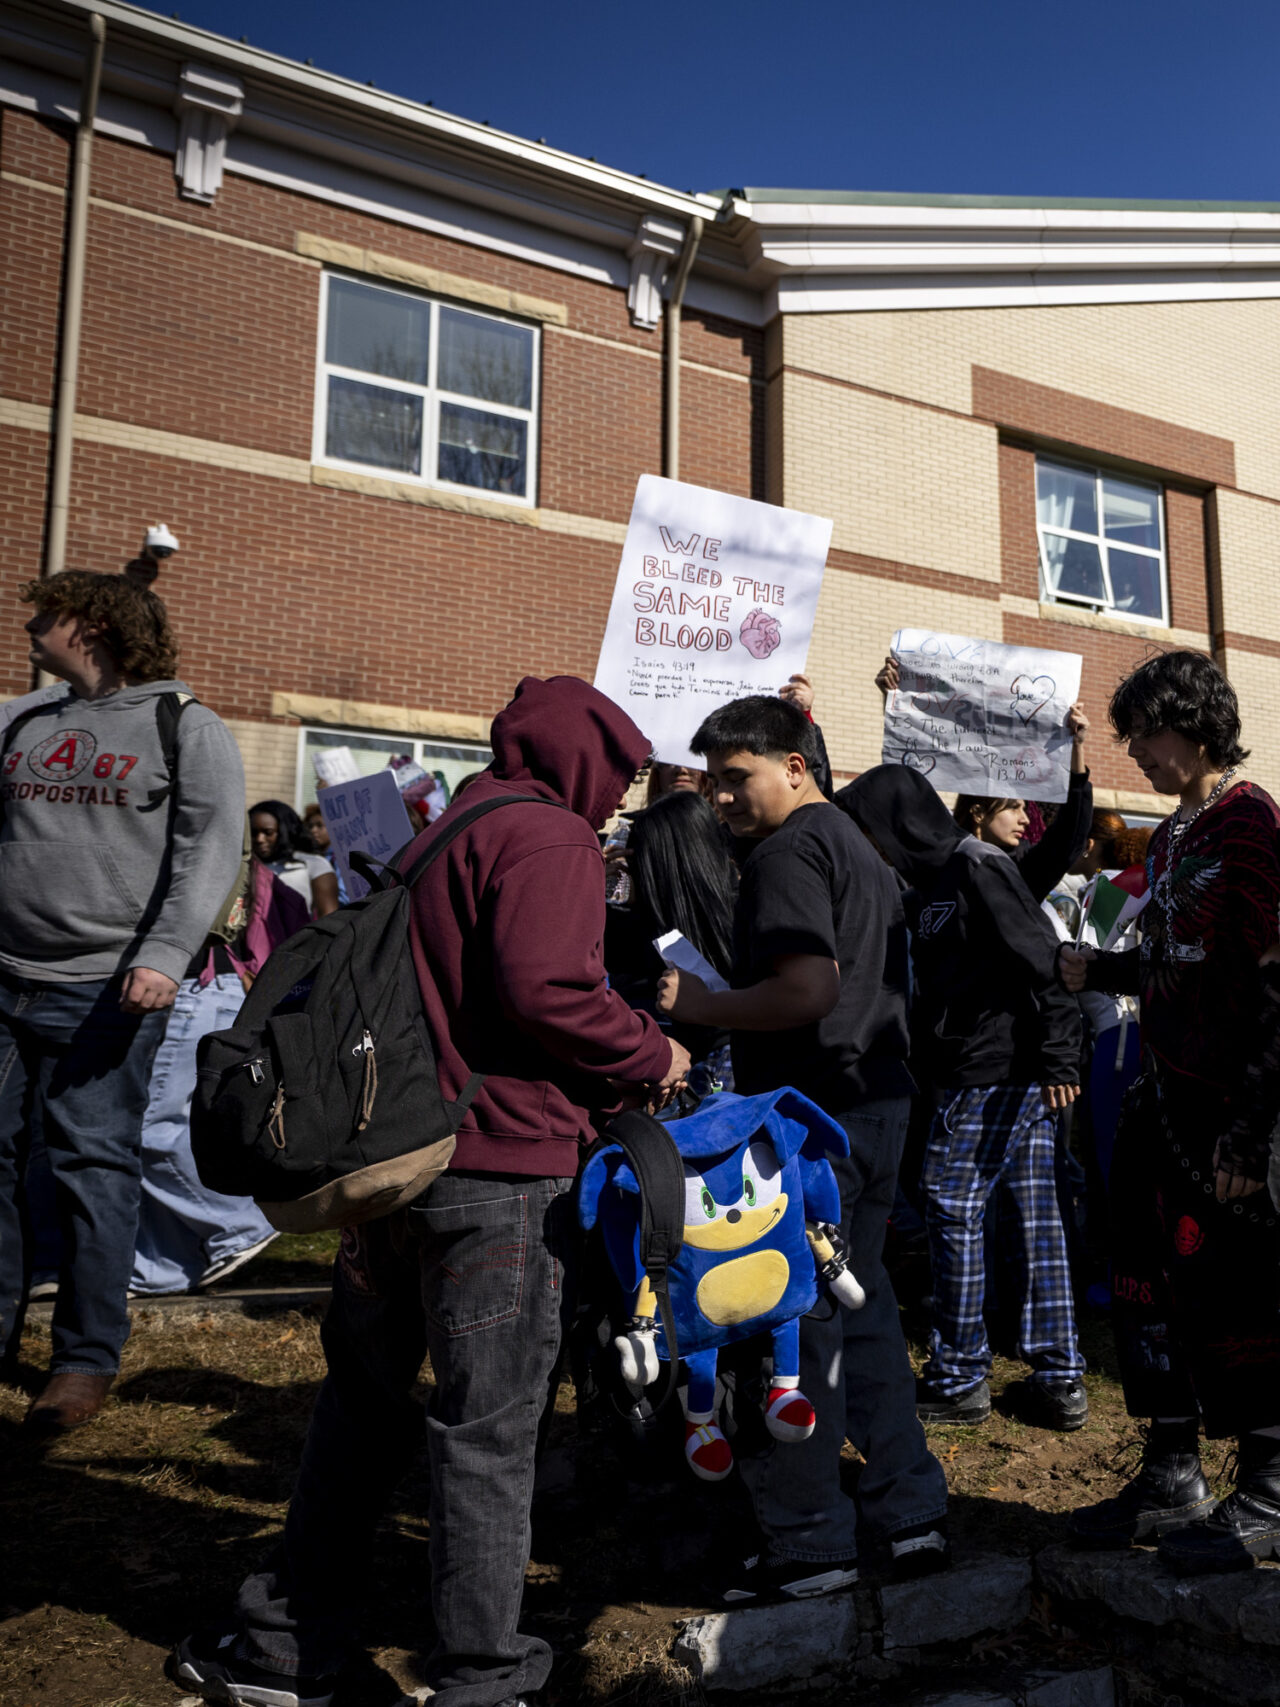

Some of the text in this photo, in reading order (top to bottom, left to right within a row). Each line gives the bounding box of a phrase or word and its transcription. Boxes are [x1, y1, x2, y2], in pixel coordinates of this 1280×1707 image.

[658, 526, 722, 561] WE
[643, 555, 784, 606] BLEED THE
[633, 581, 732, 622] SAME
[635, 617, 732, 651] BLOOD
[895, 630, 985, 660] LOVE
[891, 691, 970, 714] LOVE
[93, 752, 139, 781] 87
